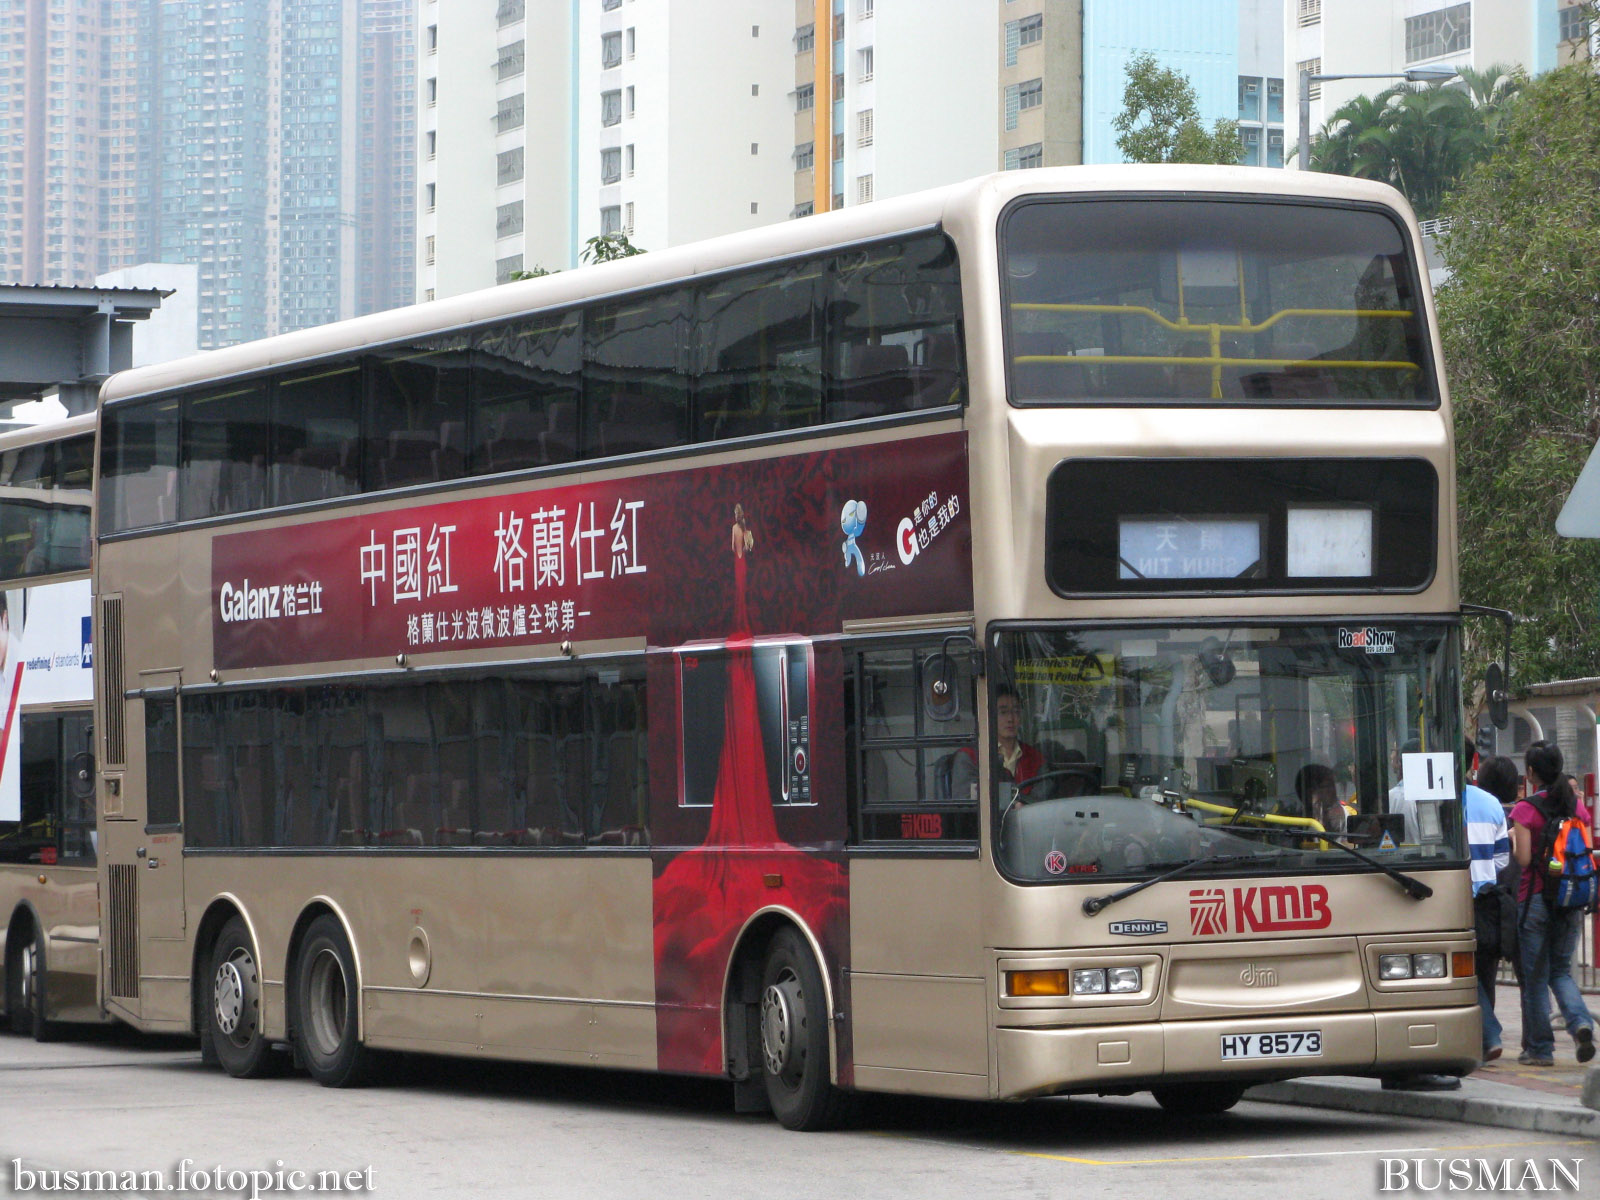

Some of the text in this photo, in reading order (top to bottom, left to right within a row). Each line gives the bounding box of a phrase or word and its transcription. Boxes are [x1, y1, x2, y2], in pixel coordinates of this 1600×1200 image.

[913, 490, 938, 526] 是你的
[918, 494, 960, 549] 也是我的
[359, 497, 647, 607] 中國紅 格蘭仕紅
[220, 578, 323, 624] Galanz 格兰仕
[406, 598, 592, 647] 格蘭仕光波微波爐全球第一
[1338, 626, 1396, 648] RoadShow
[55, 652, 80, 668] standards
[1110, 921, 1168, 934] DENNIS
[1222, 1033, 1321, 1056] HY 8573
